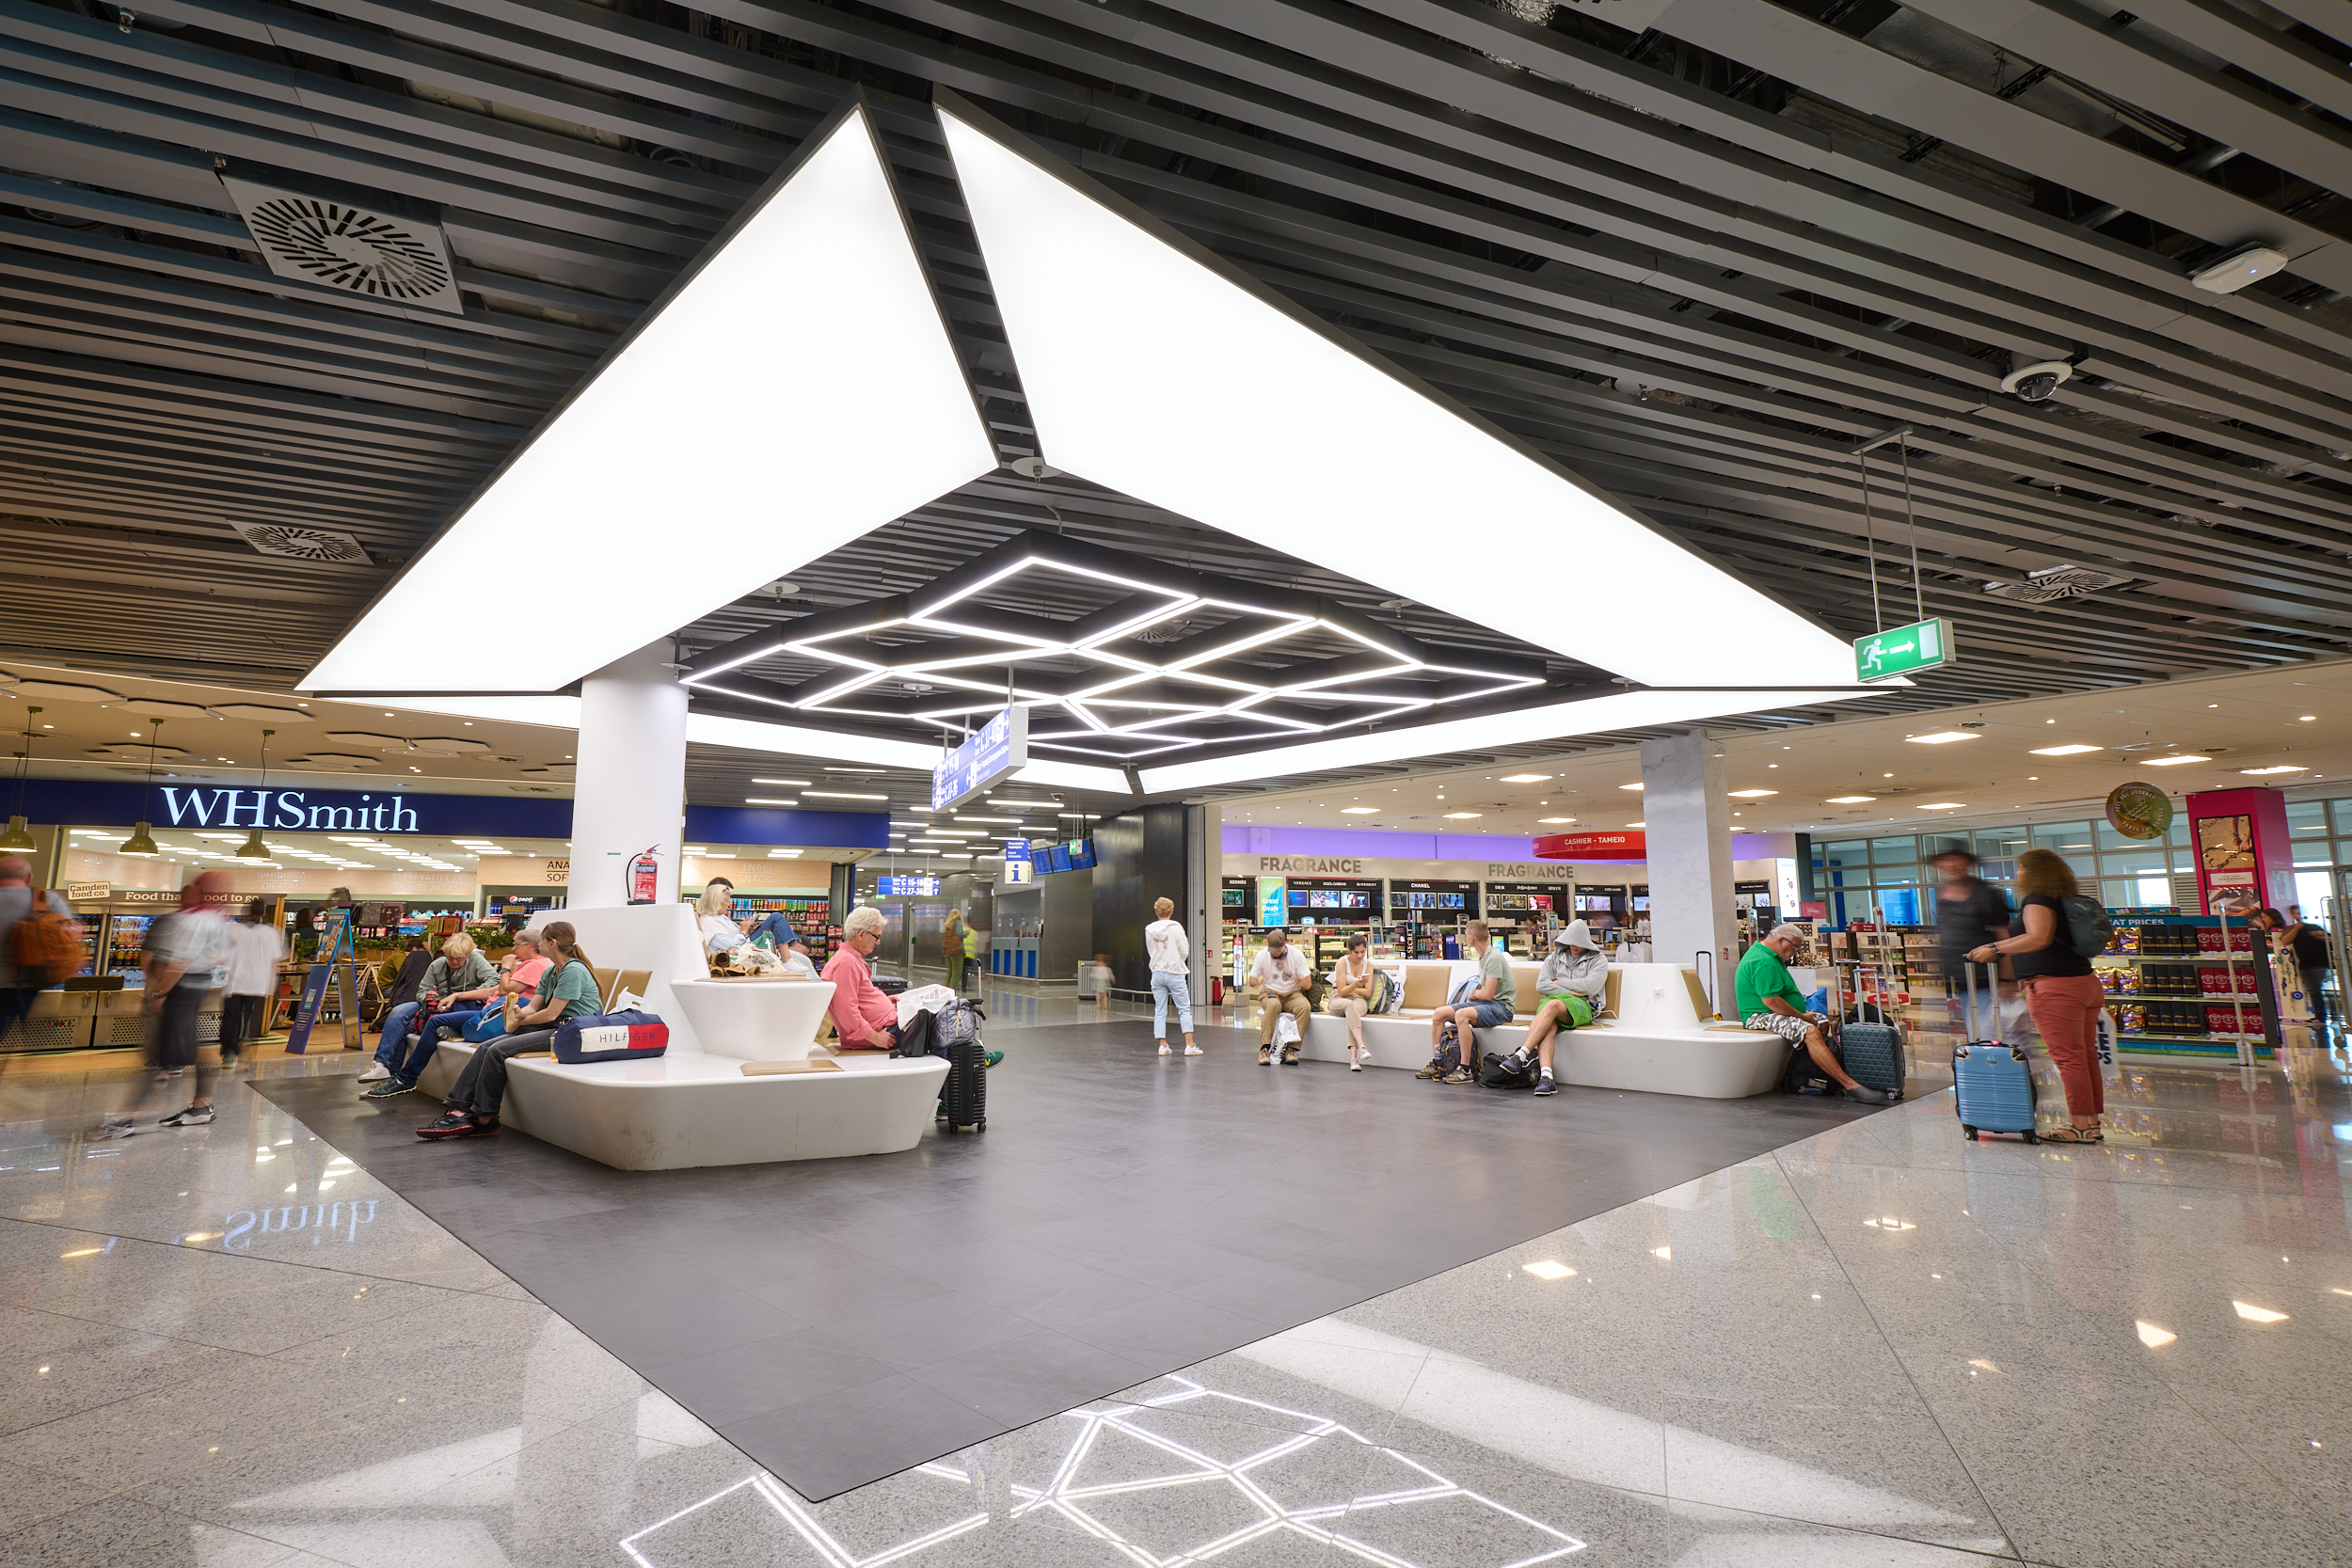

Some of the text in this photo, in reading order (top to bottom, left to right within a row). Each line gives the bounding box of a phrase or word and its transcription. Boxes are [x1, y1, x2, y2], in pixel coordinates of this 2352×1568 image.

[160, 786, 420, 832] WHSmith
[742, 863, 773, 871] ΣΝΑΚΣ
[1260, 856, 1361, 873] FRAGRANCE
[256, 871, 307, 880] ΨΗΦΙΑΚΑ
[1488, 863, 1573, 879] FRAGRANCE
[453, 874, 477, 882] ΤΑΞΙΔ
[739, 875, 776, 883] SNACKS
[261, 882, 299, 891] DIGITAL
[393, 883, 477, 893] TRAVEL ACCESSOR
[72, 890, 92, 898] food
[125, 892, 159, 900] Food
[599, 1032, 656, 1043] HILFIGER
